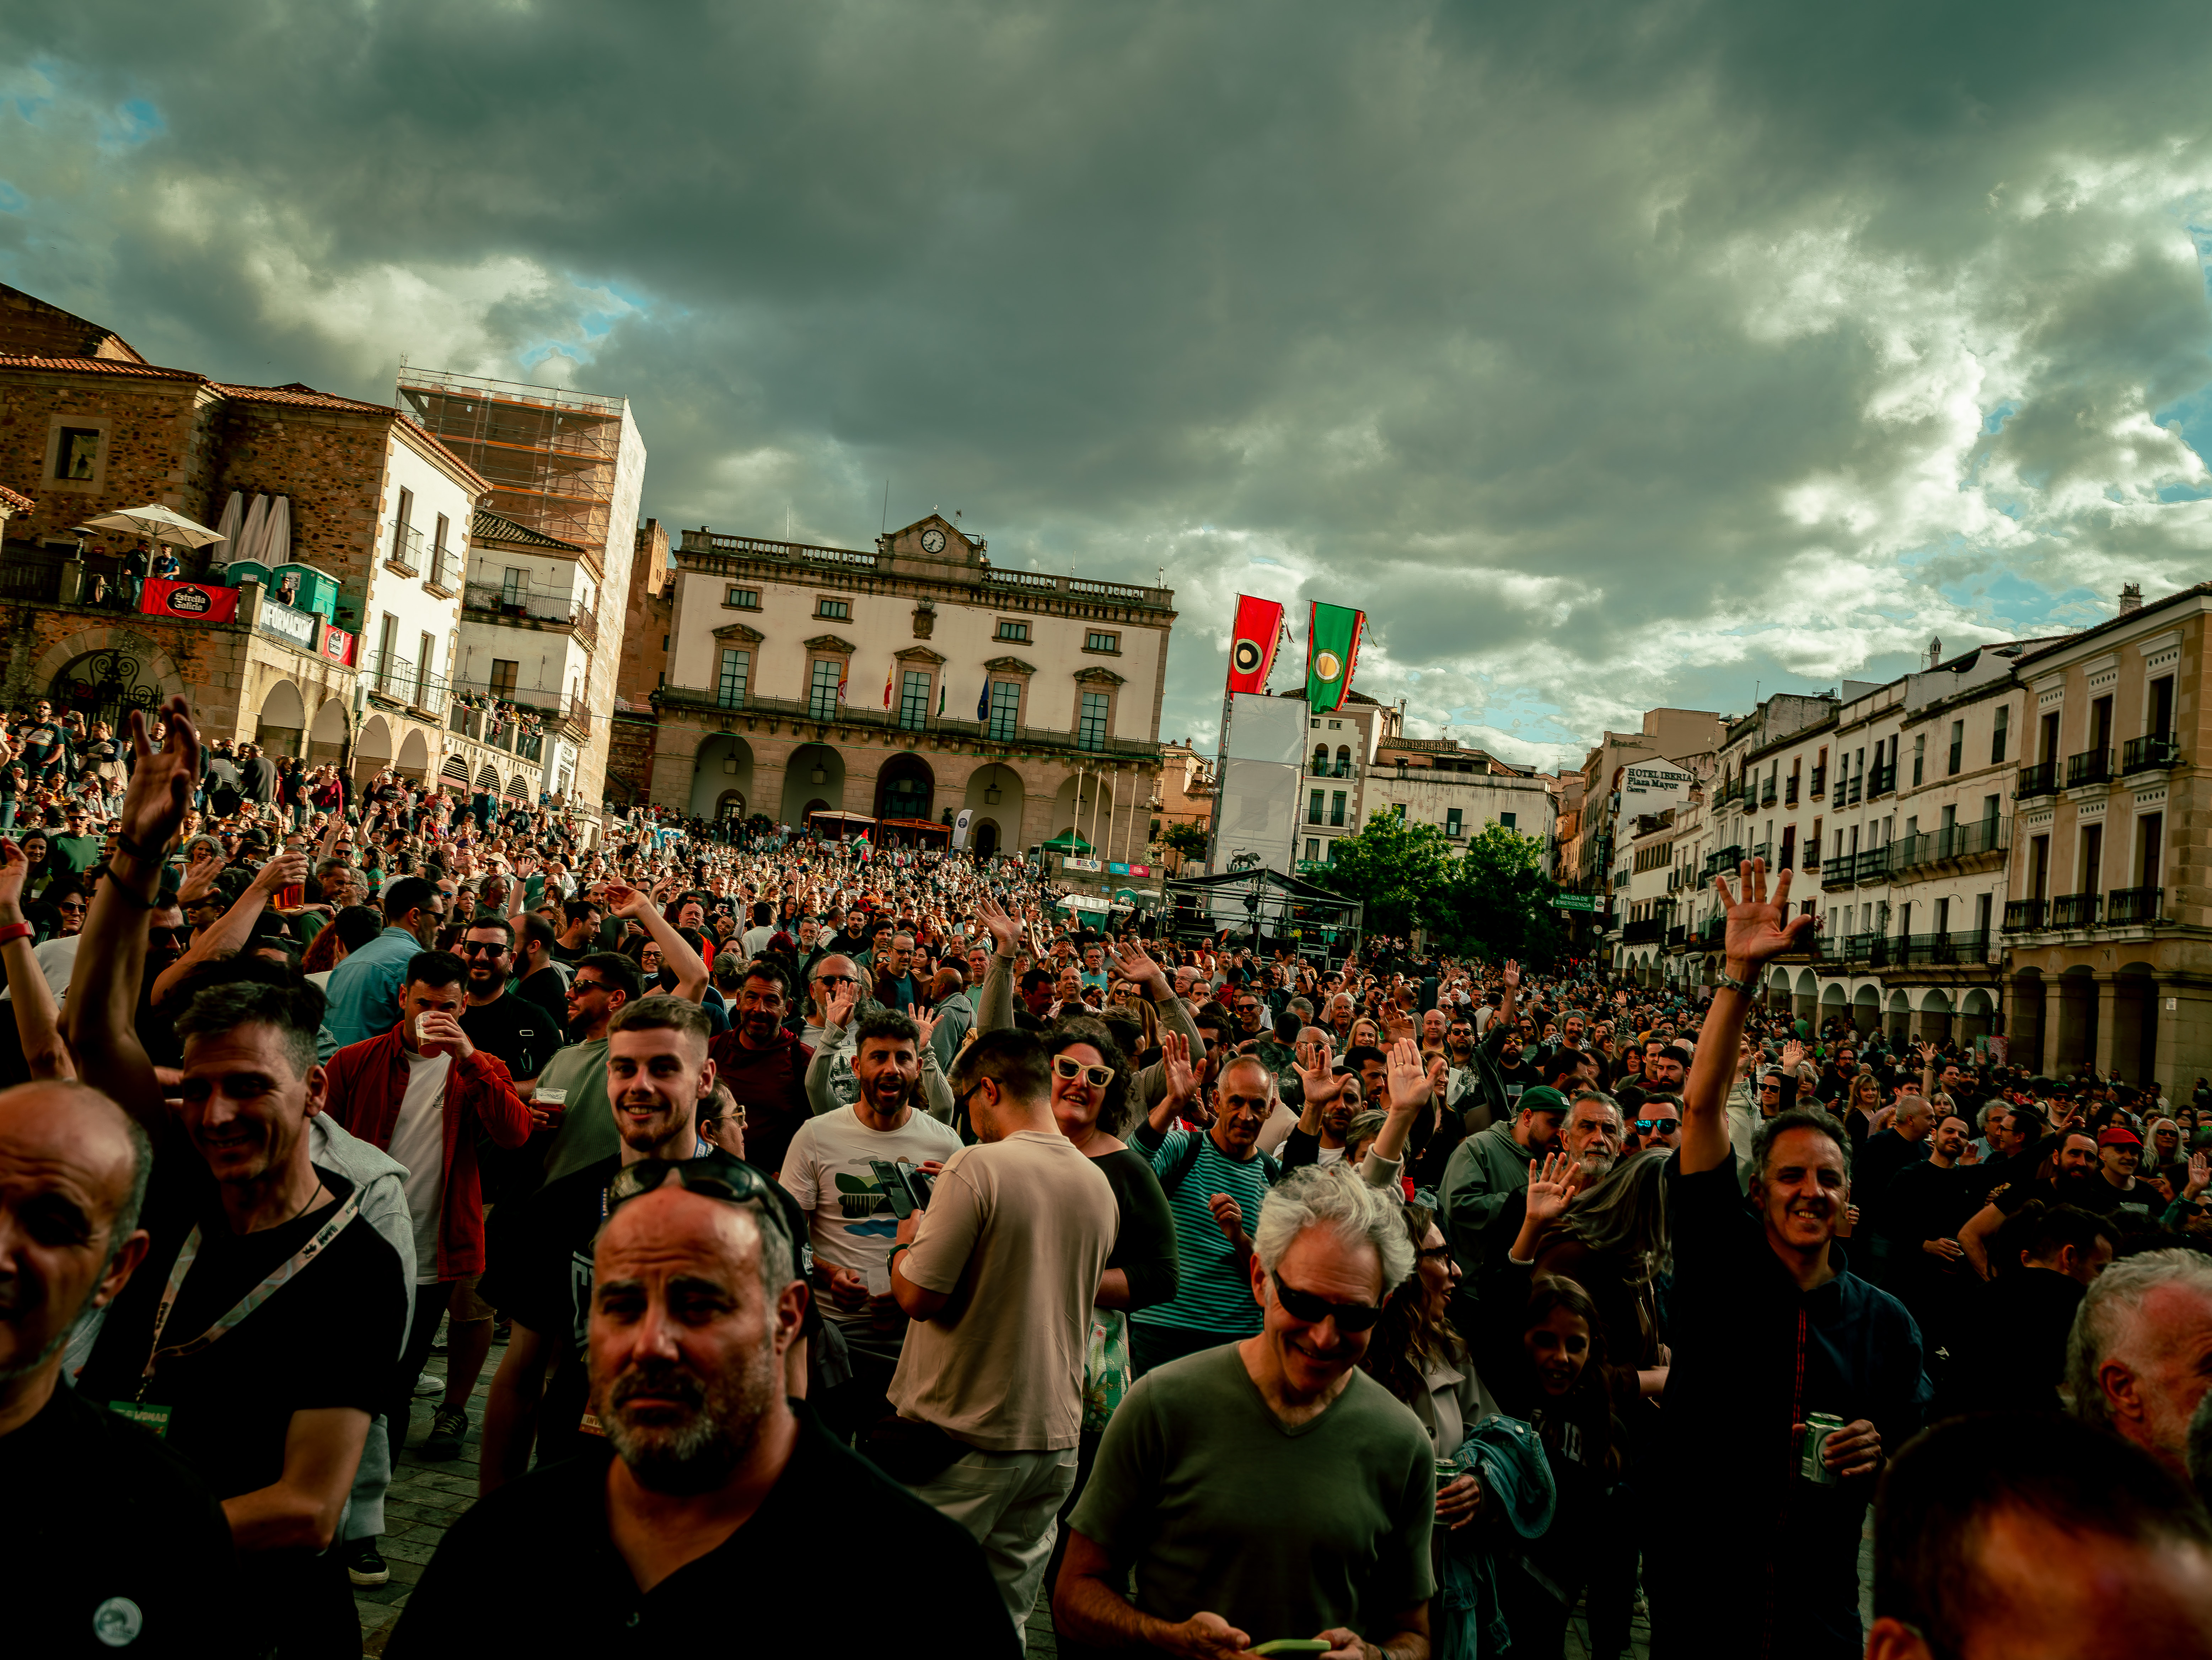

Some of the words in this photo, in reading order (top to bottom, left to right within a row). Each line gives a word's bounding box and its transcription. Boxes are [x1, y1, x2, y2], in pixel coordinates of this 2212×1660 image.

[174, 593, 205, 603] Estrella
[174, 600, 203, 610] Galicia
[1628, 768, 1659, 779] HOTEL
[1660, 771, 1693, 782] IBERIA
[1627, 777, 1650, 786] Plaza
[1651, 779, 1679, 791] Mayor
[1556, 900, 1591, 908] EMERGENCIA
